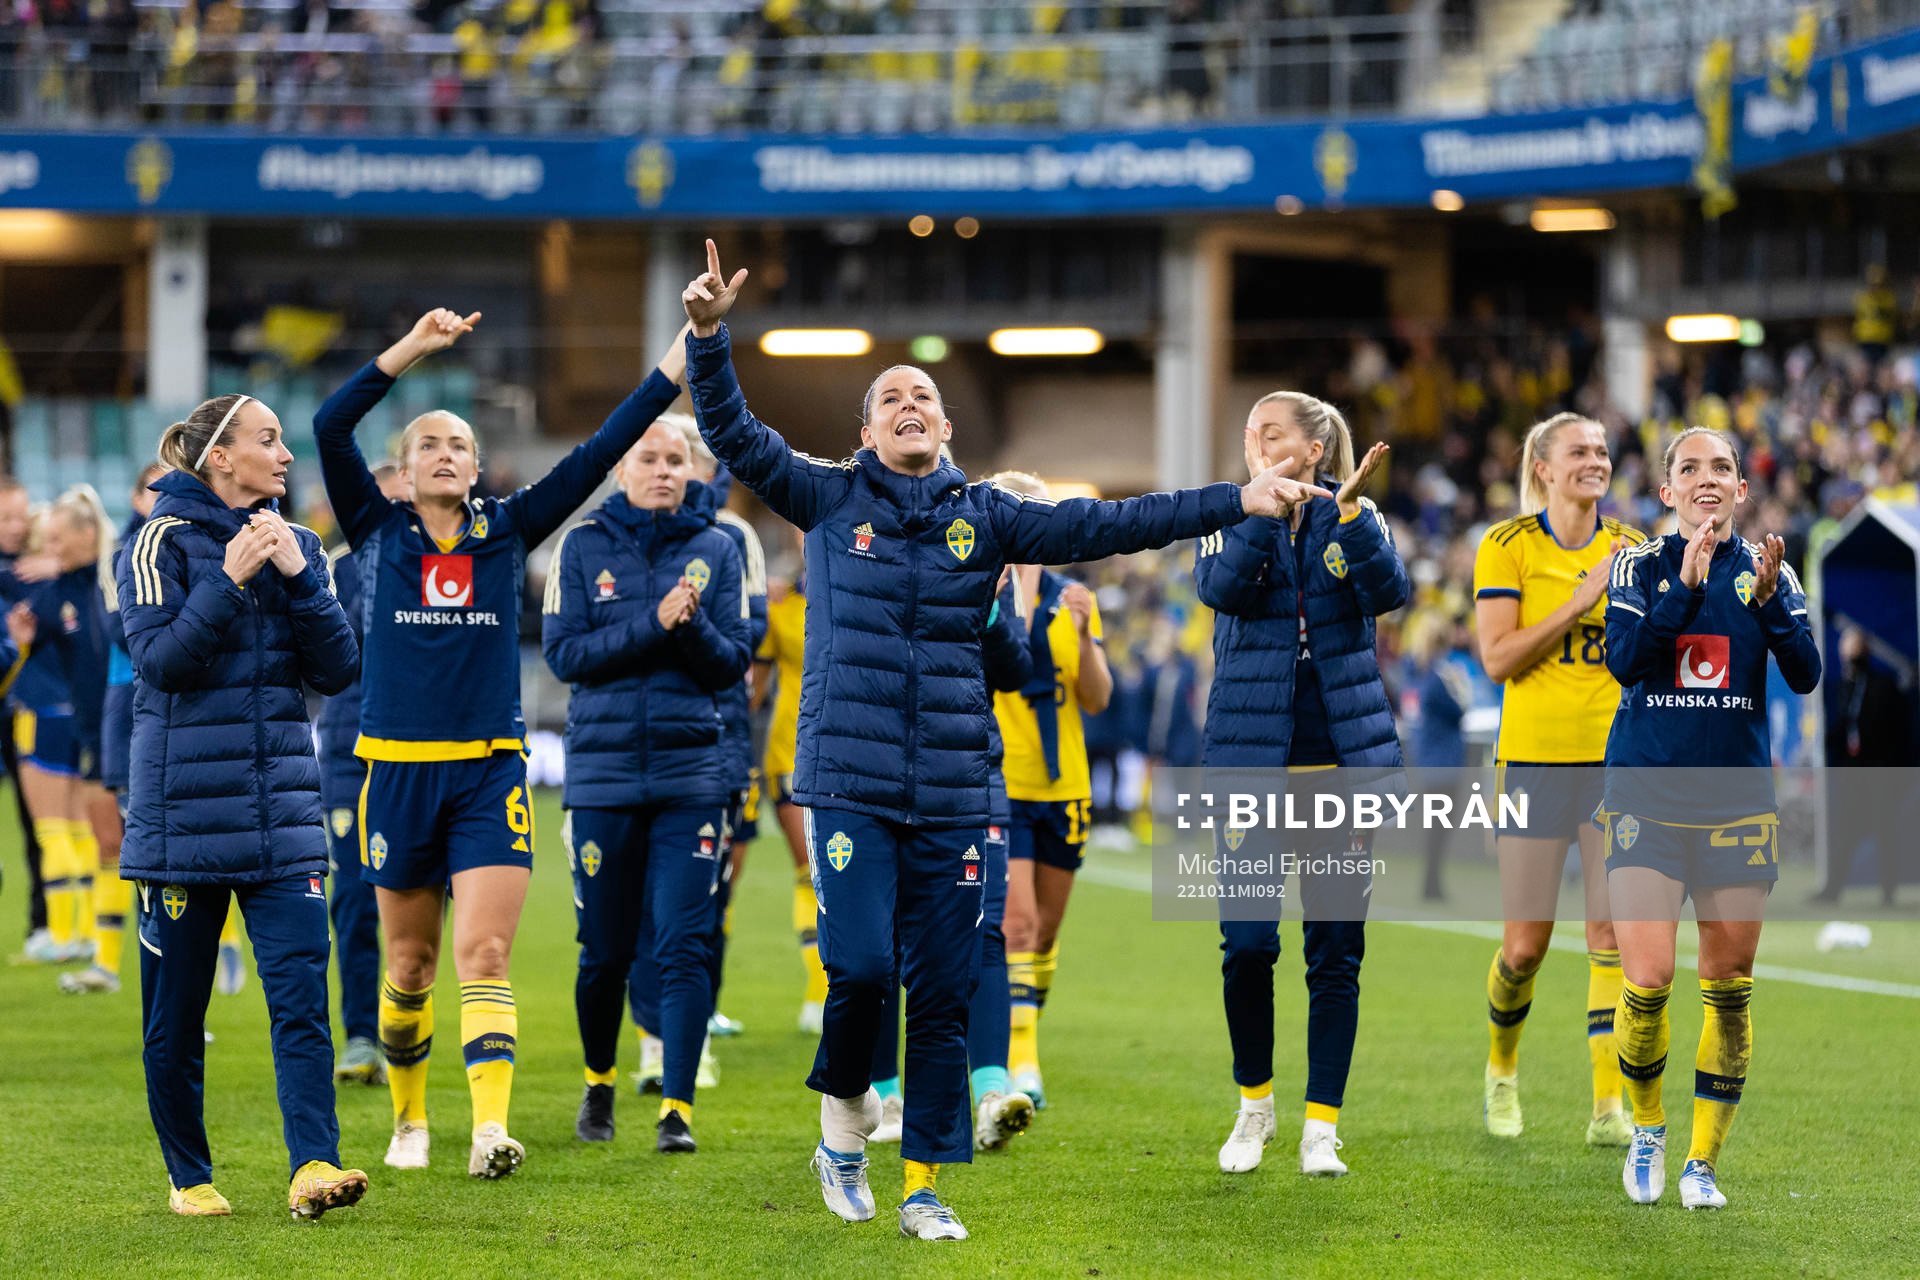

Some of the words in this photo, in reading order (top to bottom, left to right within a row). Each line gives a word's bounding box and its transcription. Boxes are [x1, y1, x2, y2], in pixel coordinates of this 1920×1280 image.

[394, 610, 463, 625] SVENSKA
[466, 612, 500, 626] SPEL
[1559, 625, 1606, 665] 18
[1646, 694, 1718, 708] SVENSKA
[1722, 695, 1754, 711] SPEL
[505, 786, 530, 835] 6
